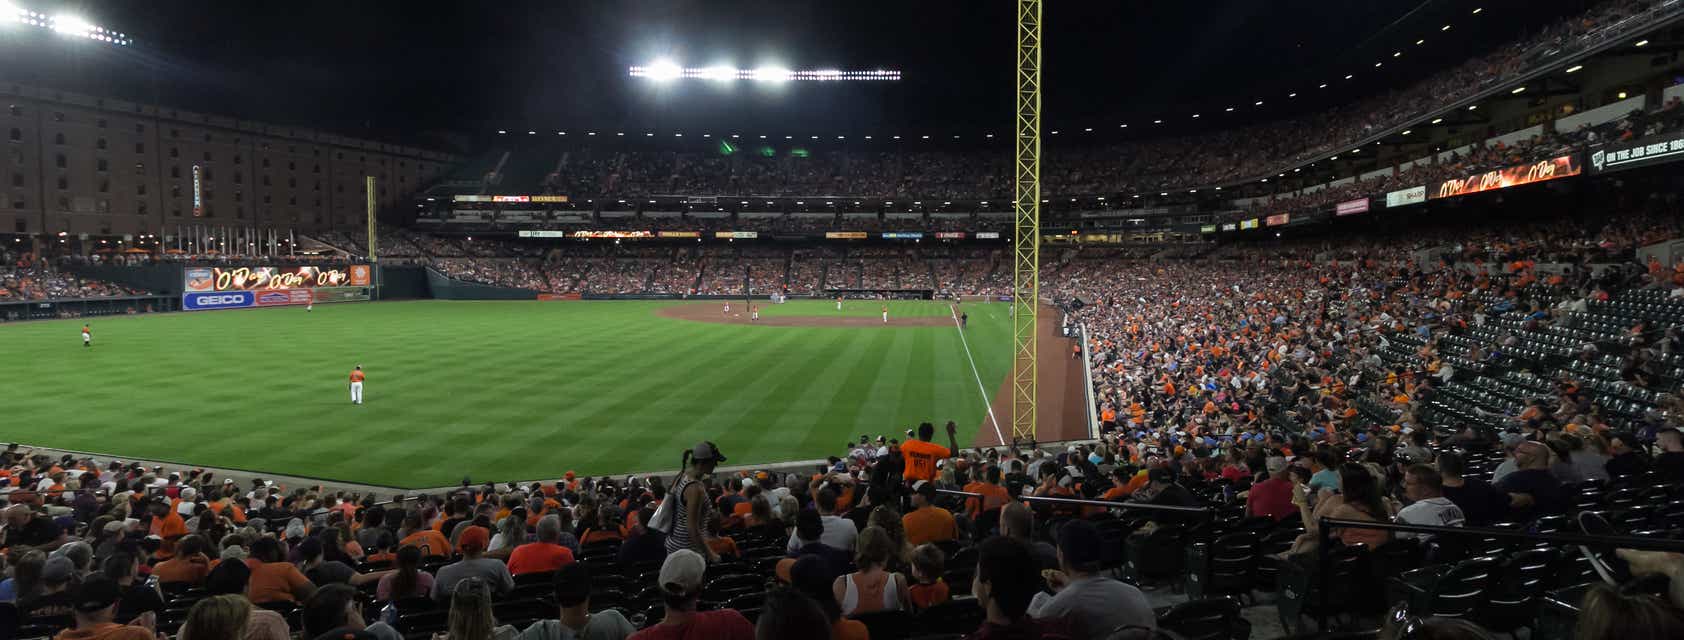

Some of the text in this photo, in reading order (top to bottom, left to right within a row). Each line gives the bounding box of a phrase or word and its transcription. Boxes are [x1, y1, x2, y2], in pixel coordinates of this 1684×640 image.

[1606, 152, 1616, 163] ON
[1617, 150, 1629, 161] THE
[1631, 147, 1645, 158] JOB
[1646, 143, 1667, 155] SINCE
[197, 295, 244, 305] GEICO
